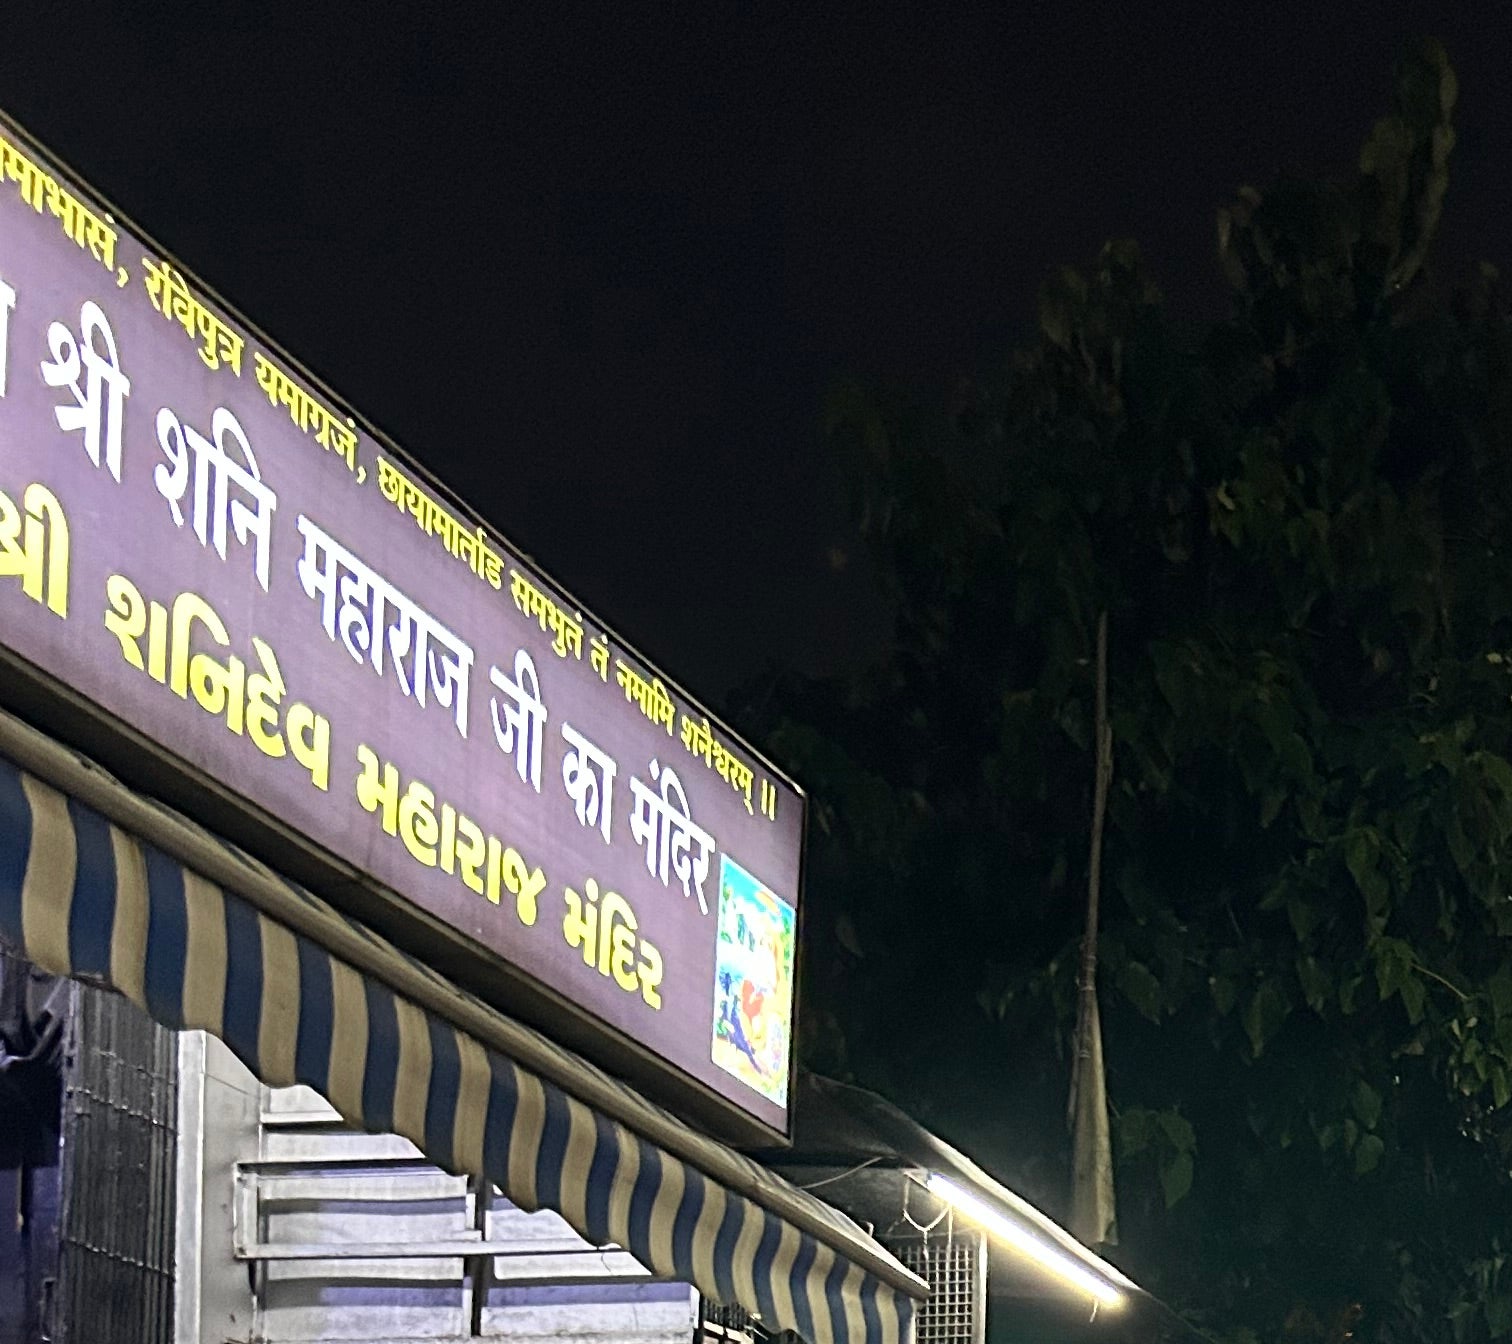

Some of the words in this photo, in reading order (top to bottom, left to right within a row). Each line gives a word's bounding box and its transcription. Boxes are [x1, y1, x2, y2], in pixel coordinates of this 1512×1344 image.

[0, 136, 129, 288] माभासं,
[142, 257, 245, 378] रविपुत्र
[590, 632, 610, 683] तं
[616, 659, 676, 737] नमामि
[40, 300, 131, 484] श्री
[154, 406, 277, 593] शनि
[297, 512, 474, 739] महाराज
[489, 648, 548, 794] जी
[560, 721, 617, 845] का
[628, 757, 716, 916] मंदिर
[104, 574, 332, 793] શનિદેવ
[356, 743, 547, 927] મહારાજ
[563, 878, 664, 1011] મંદિર
